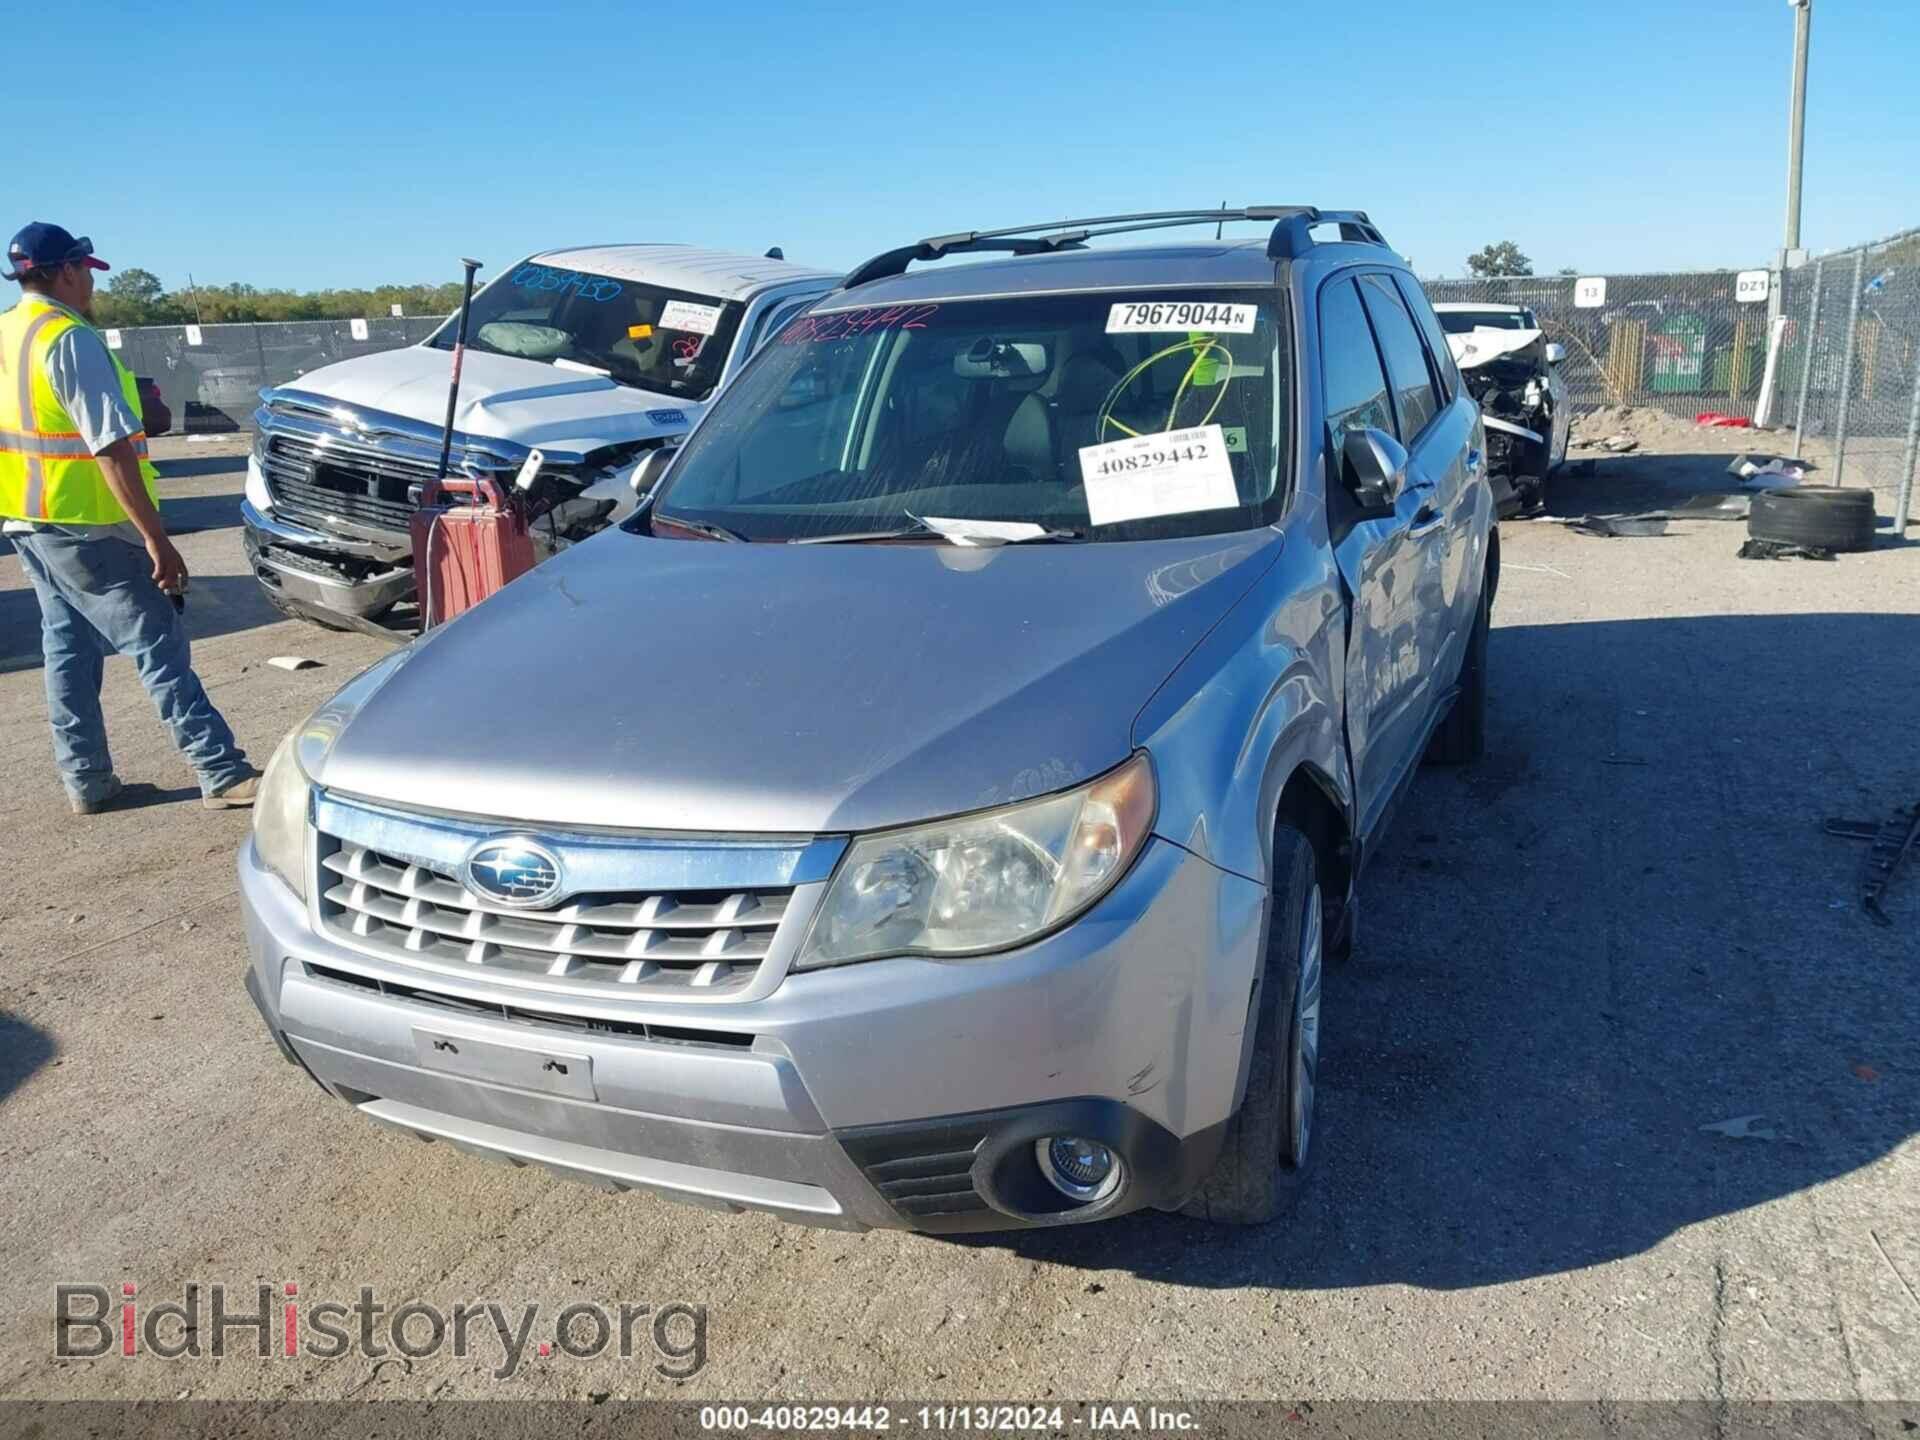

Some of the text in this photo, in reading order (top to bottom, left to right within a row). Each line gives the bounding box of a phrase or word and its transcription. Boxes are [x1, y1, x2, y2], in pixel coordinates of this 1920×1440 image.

[1739, 281, 1766, 292] DZ1
[1584, 287, 1598, 298] 13
[1097, 444, 1209, 475] 40829442
